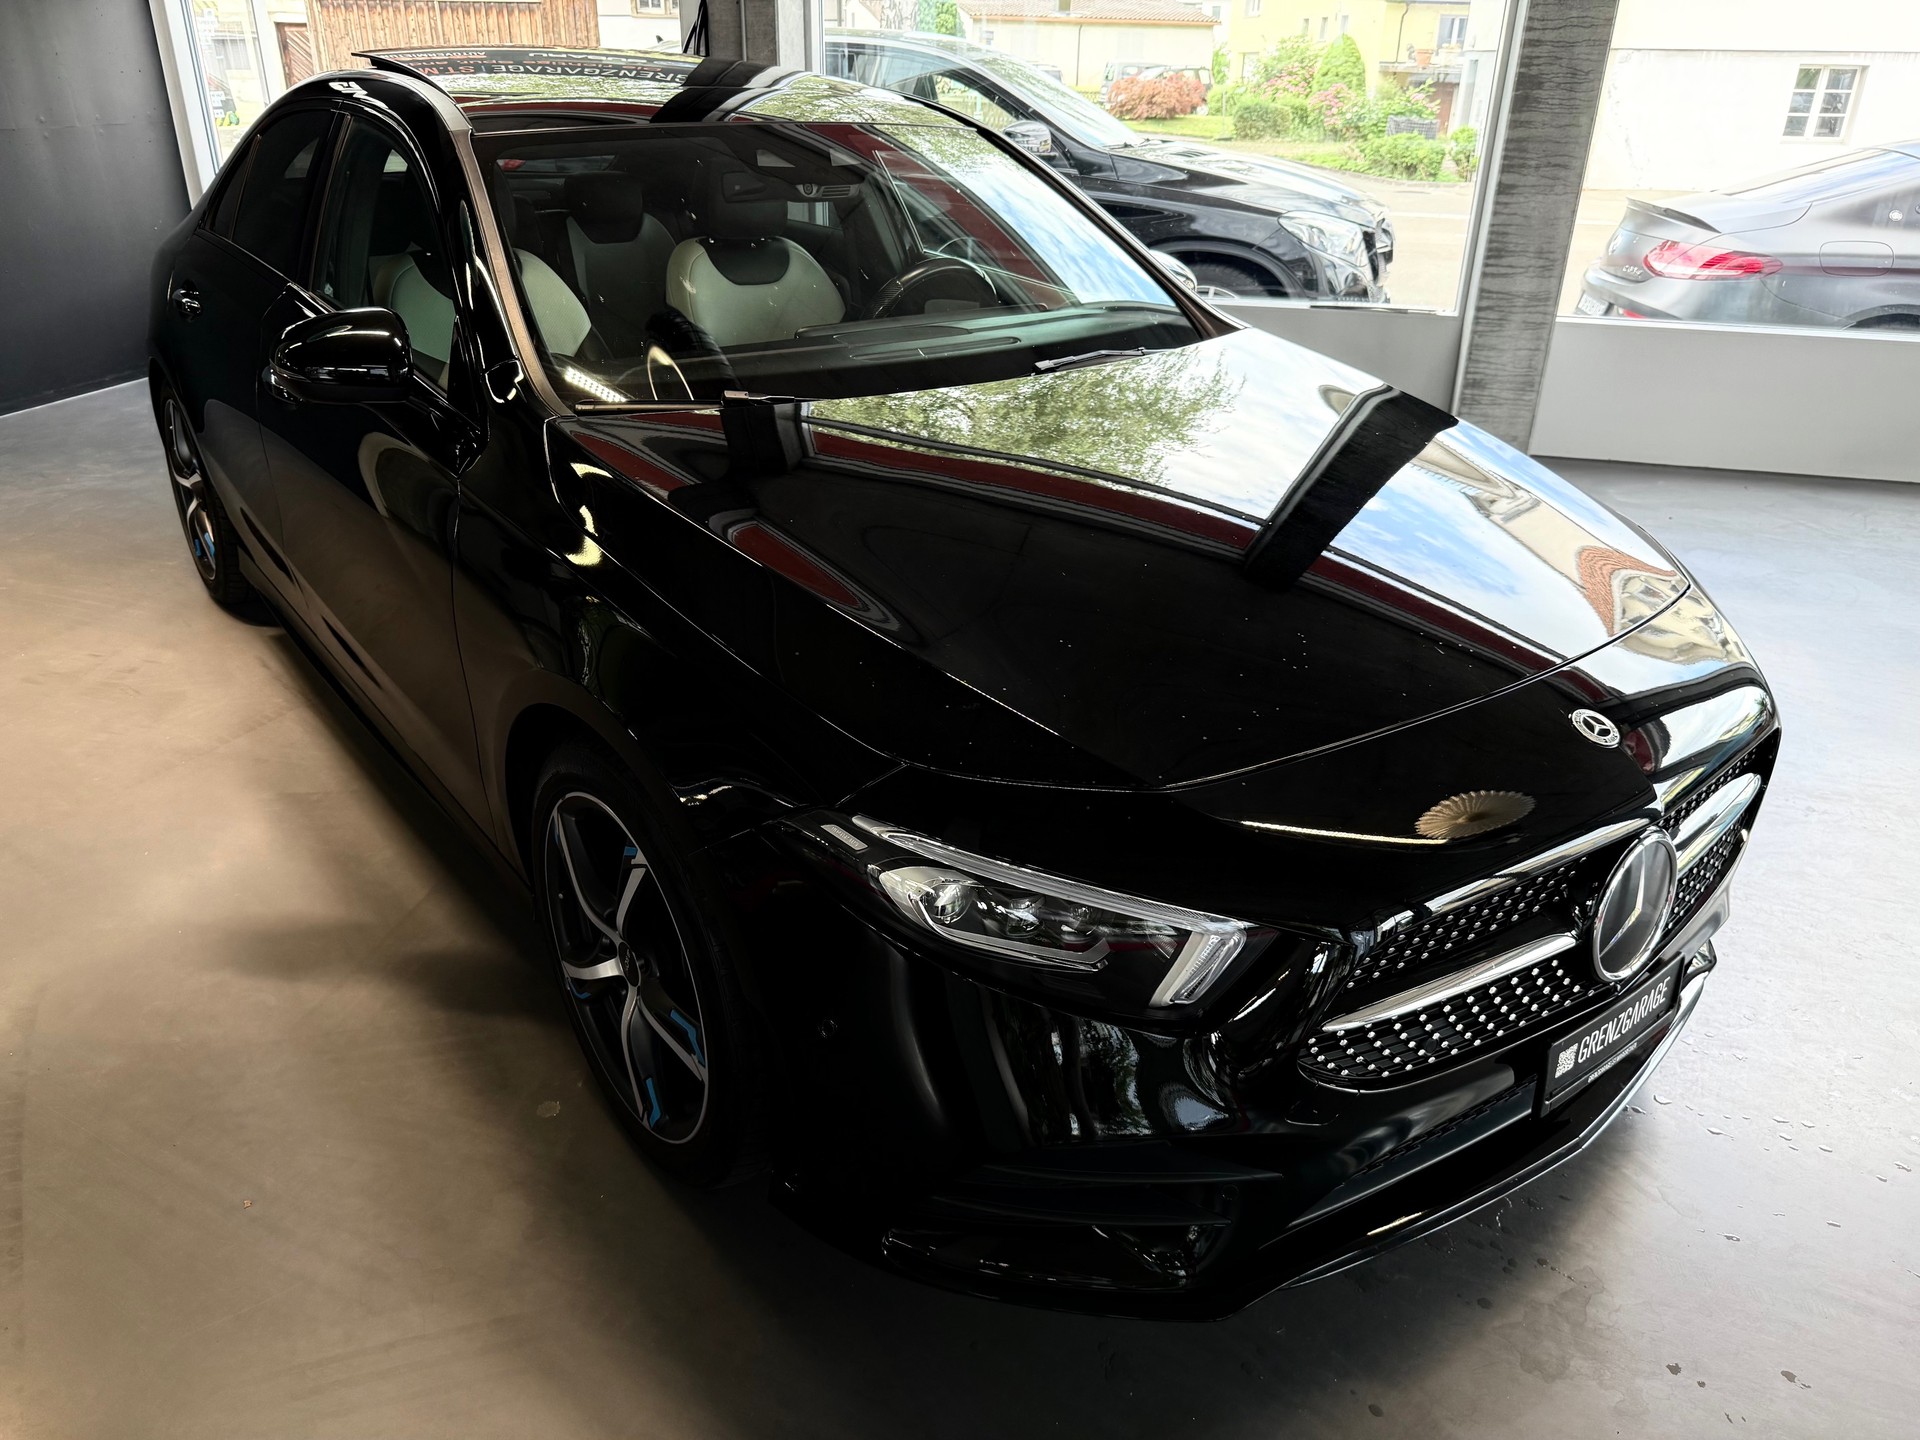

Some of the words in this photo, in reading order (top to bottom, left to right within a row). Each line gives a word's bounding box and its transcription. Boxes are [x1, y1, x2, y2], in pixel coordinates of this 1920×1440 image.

[529, 52, 648, 63] SUBARU
[493, 64, 688, 83] GRENZGARAGE
[1578, 976, 1671, 1063] GRENZGARAGE
